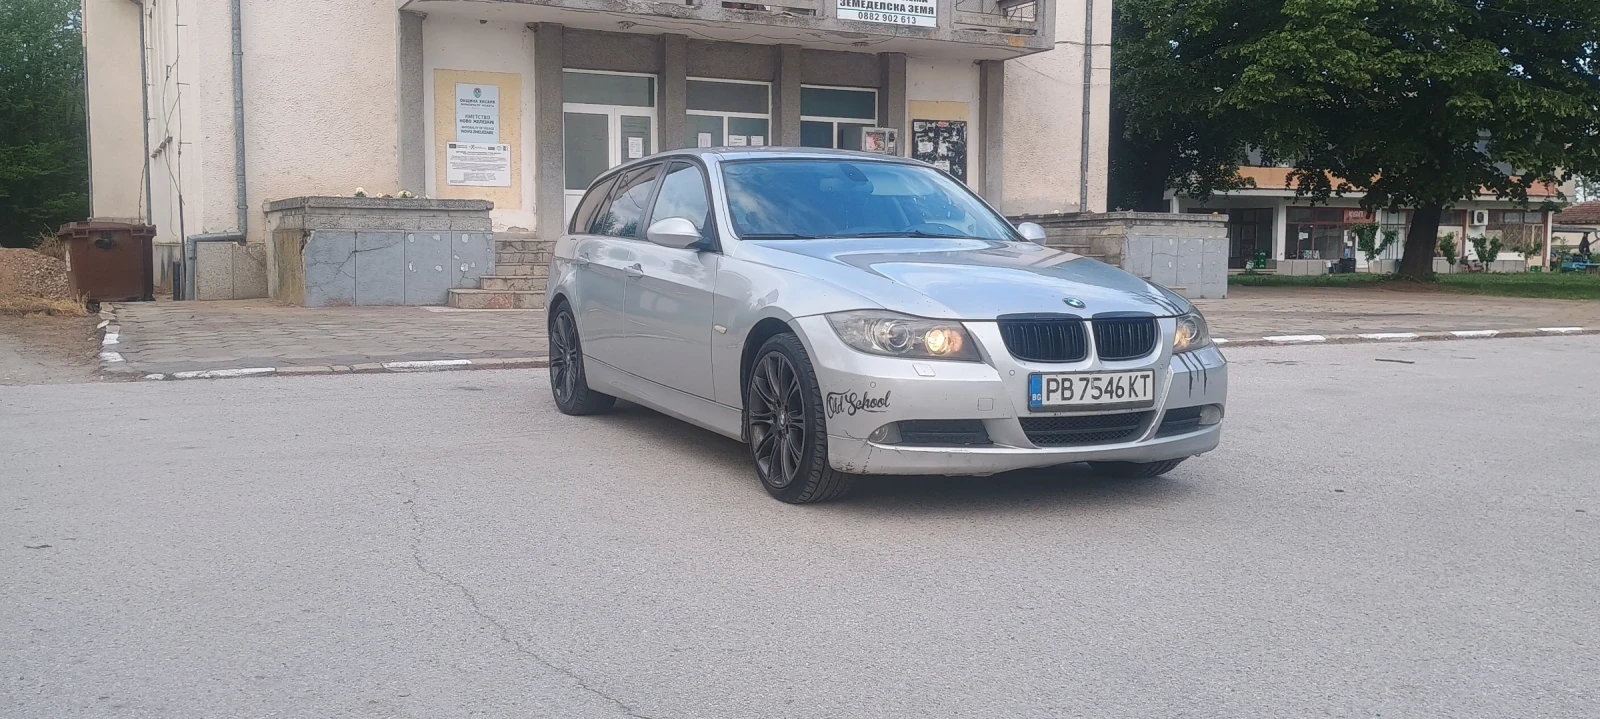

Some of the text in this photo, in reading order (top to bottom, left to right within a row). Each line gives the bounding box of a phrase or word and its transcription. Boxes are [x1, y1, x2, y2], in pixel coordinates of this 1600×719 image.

[858, 11, 916, 24] 0882 902 613
[908, 4, 934, 14] ЗЕМЯ
[1046, 374, 1150, 401] PB 7546 KT
[827, 389, 891, 419] Old School
